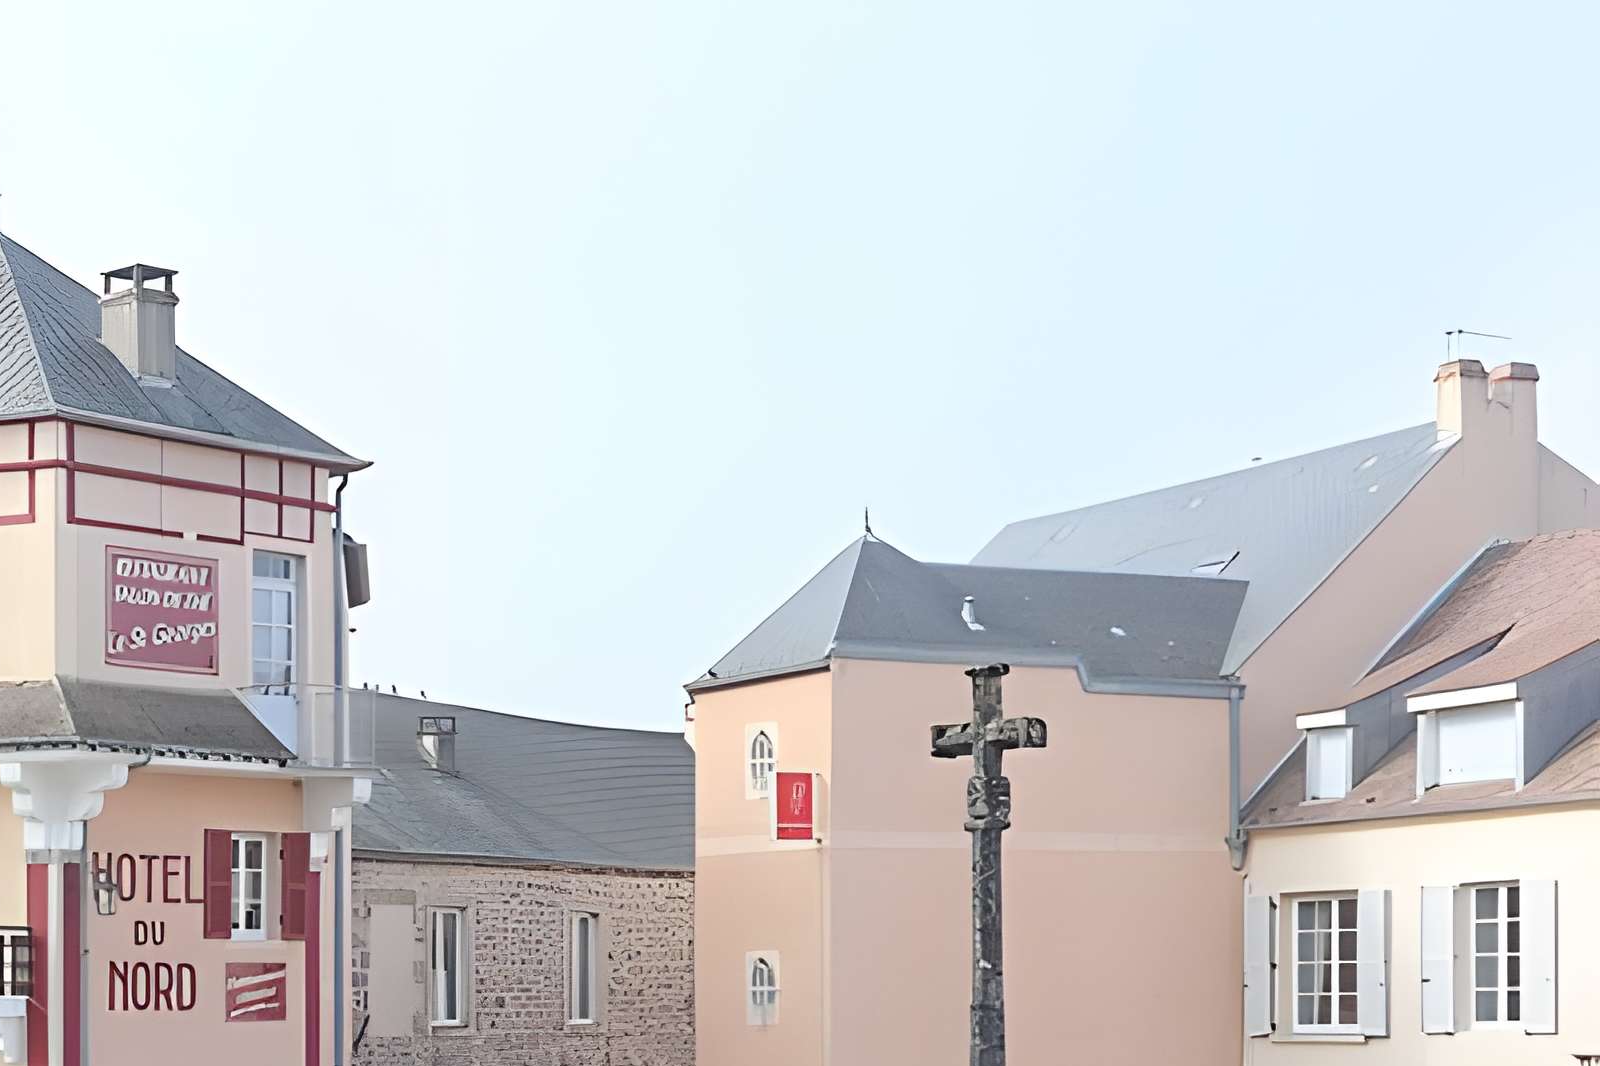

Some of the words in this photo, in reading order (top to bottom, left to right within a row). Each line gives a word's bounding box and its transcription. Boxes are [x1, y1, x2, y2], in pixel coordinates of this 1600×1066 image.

[91, 851, 204, 904] HOTEL
[134, 920, 165, 946] DU
[108, 960, 197, 1012] NORD
